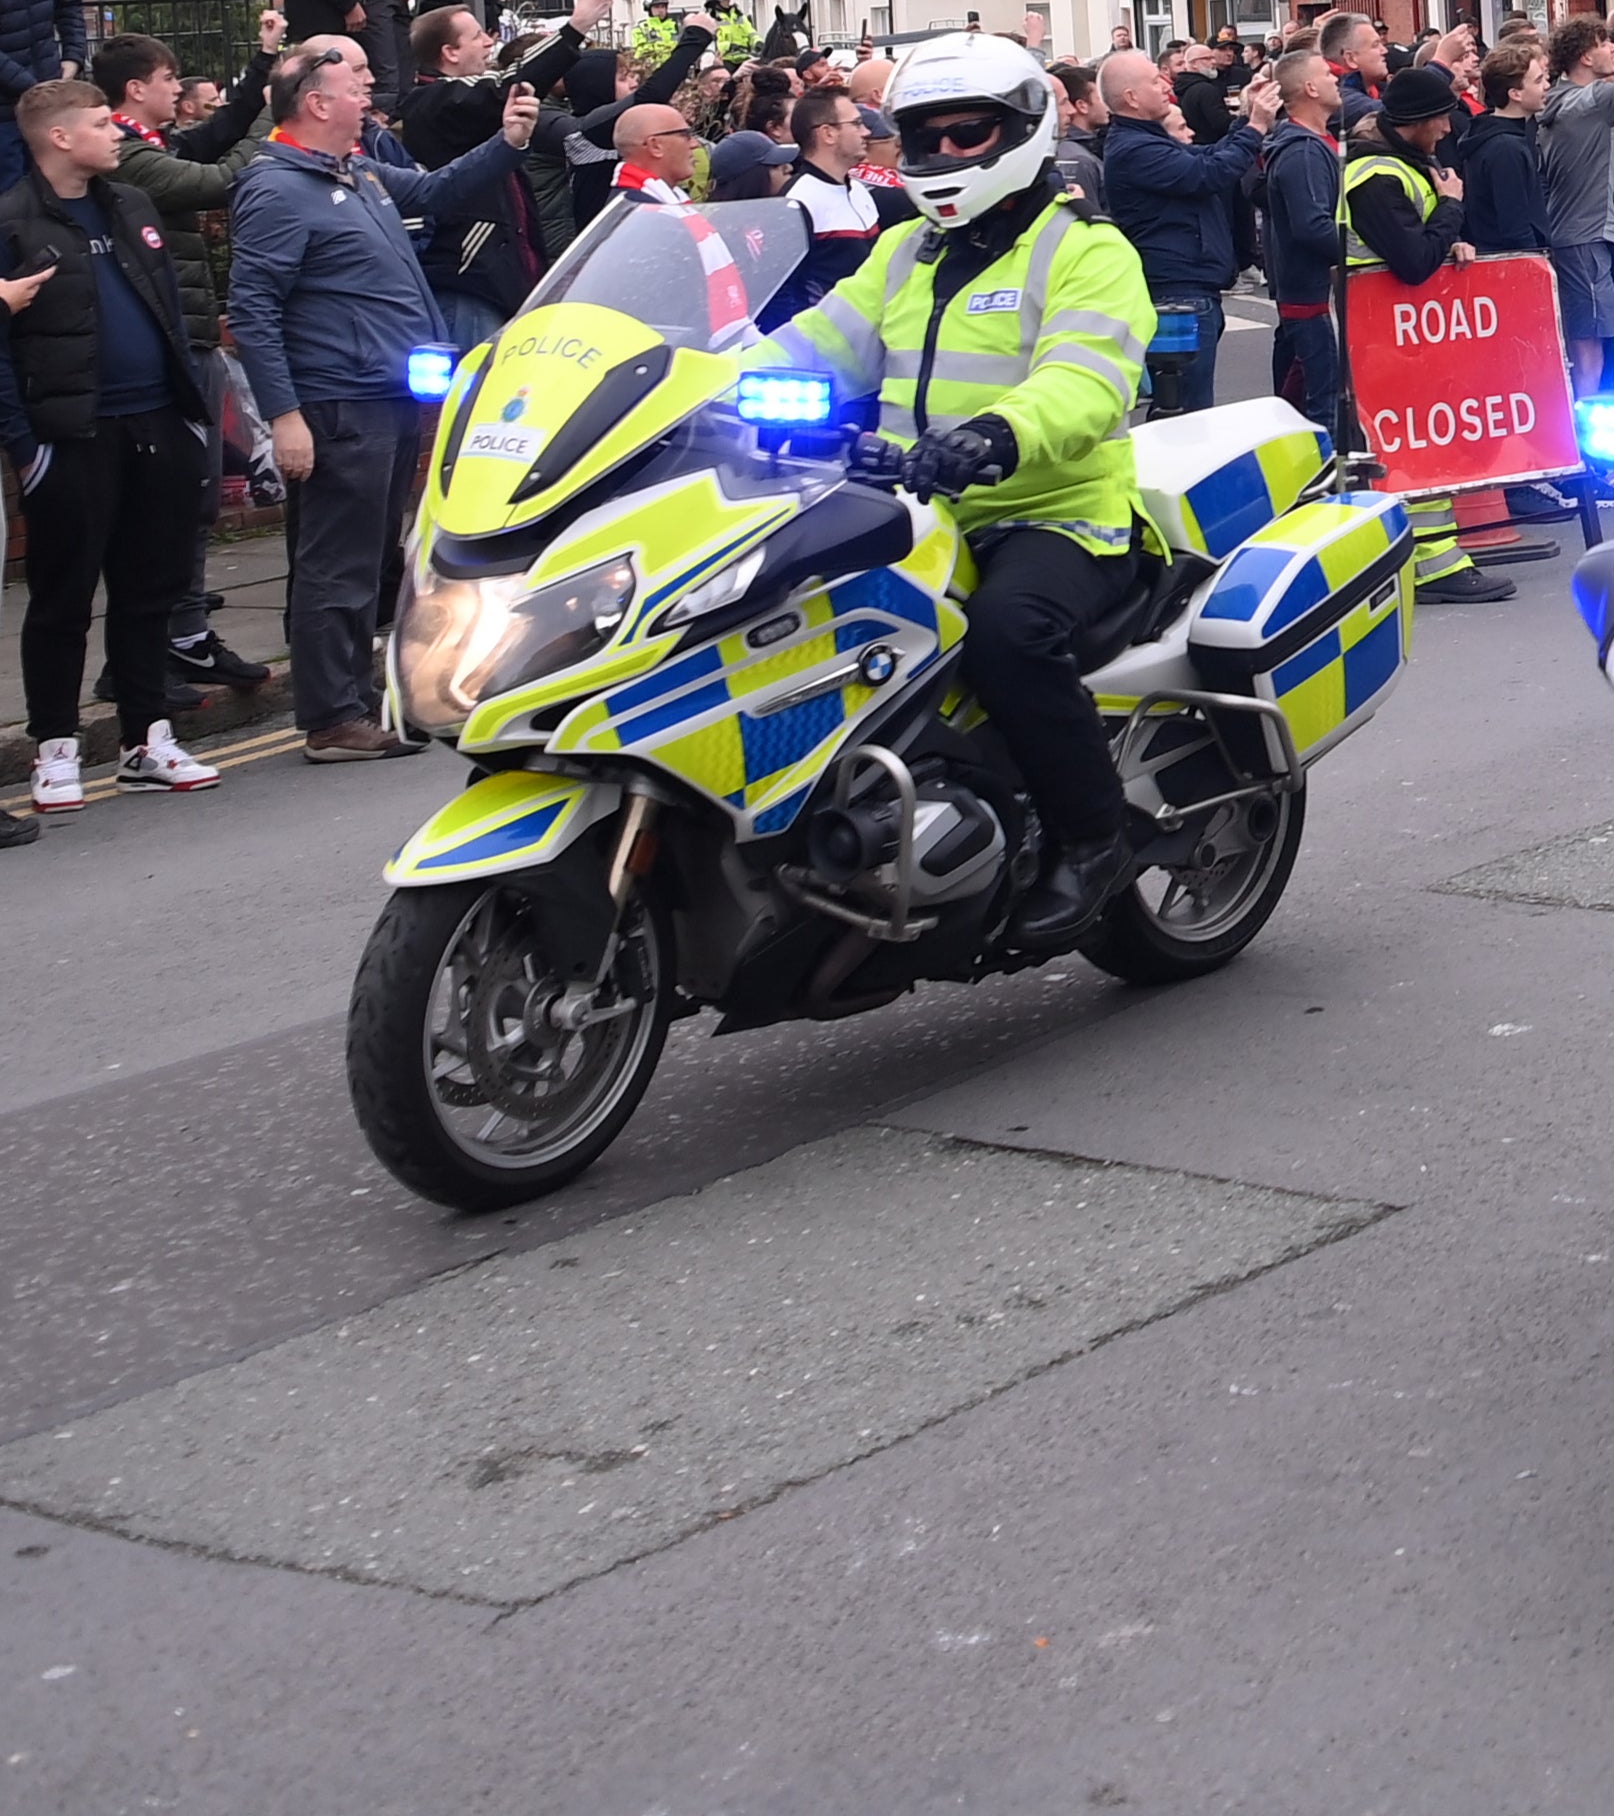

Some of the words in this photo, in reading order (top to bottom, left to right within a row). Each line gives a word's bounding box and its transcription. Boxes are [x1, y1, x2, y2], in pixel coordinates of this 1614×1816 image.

[971, 292, 1016, 309] POLICE
[1393, 296, 1498, 346] ROAD
[501, 336, 603, 369] POLICE
[1374, 392, 1536, 453] CLOSED
[470, 435, 529, 454] POLICE
